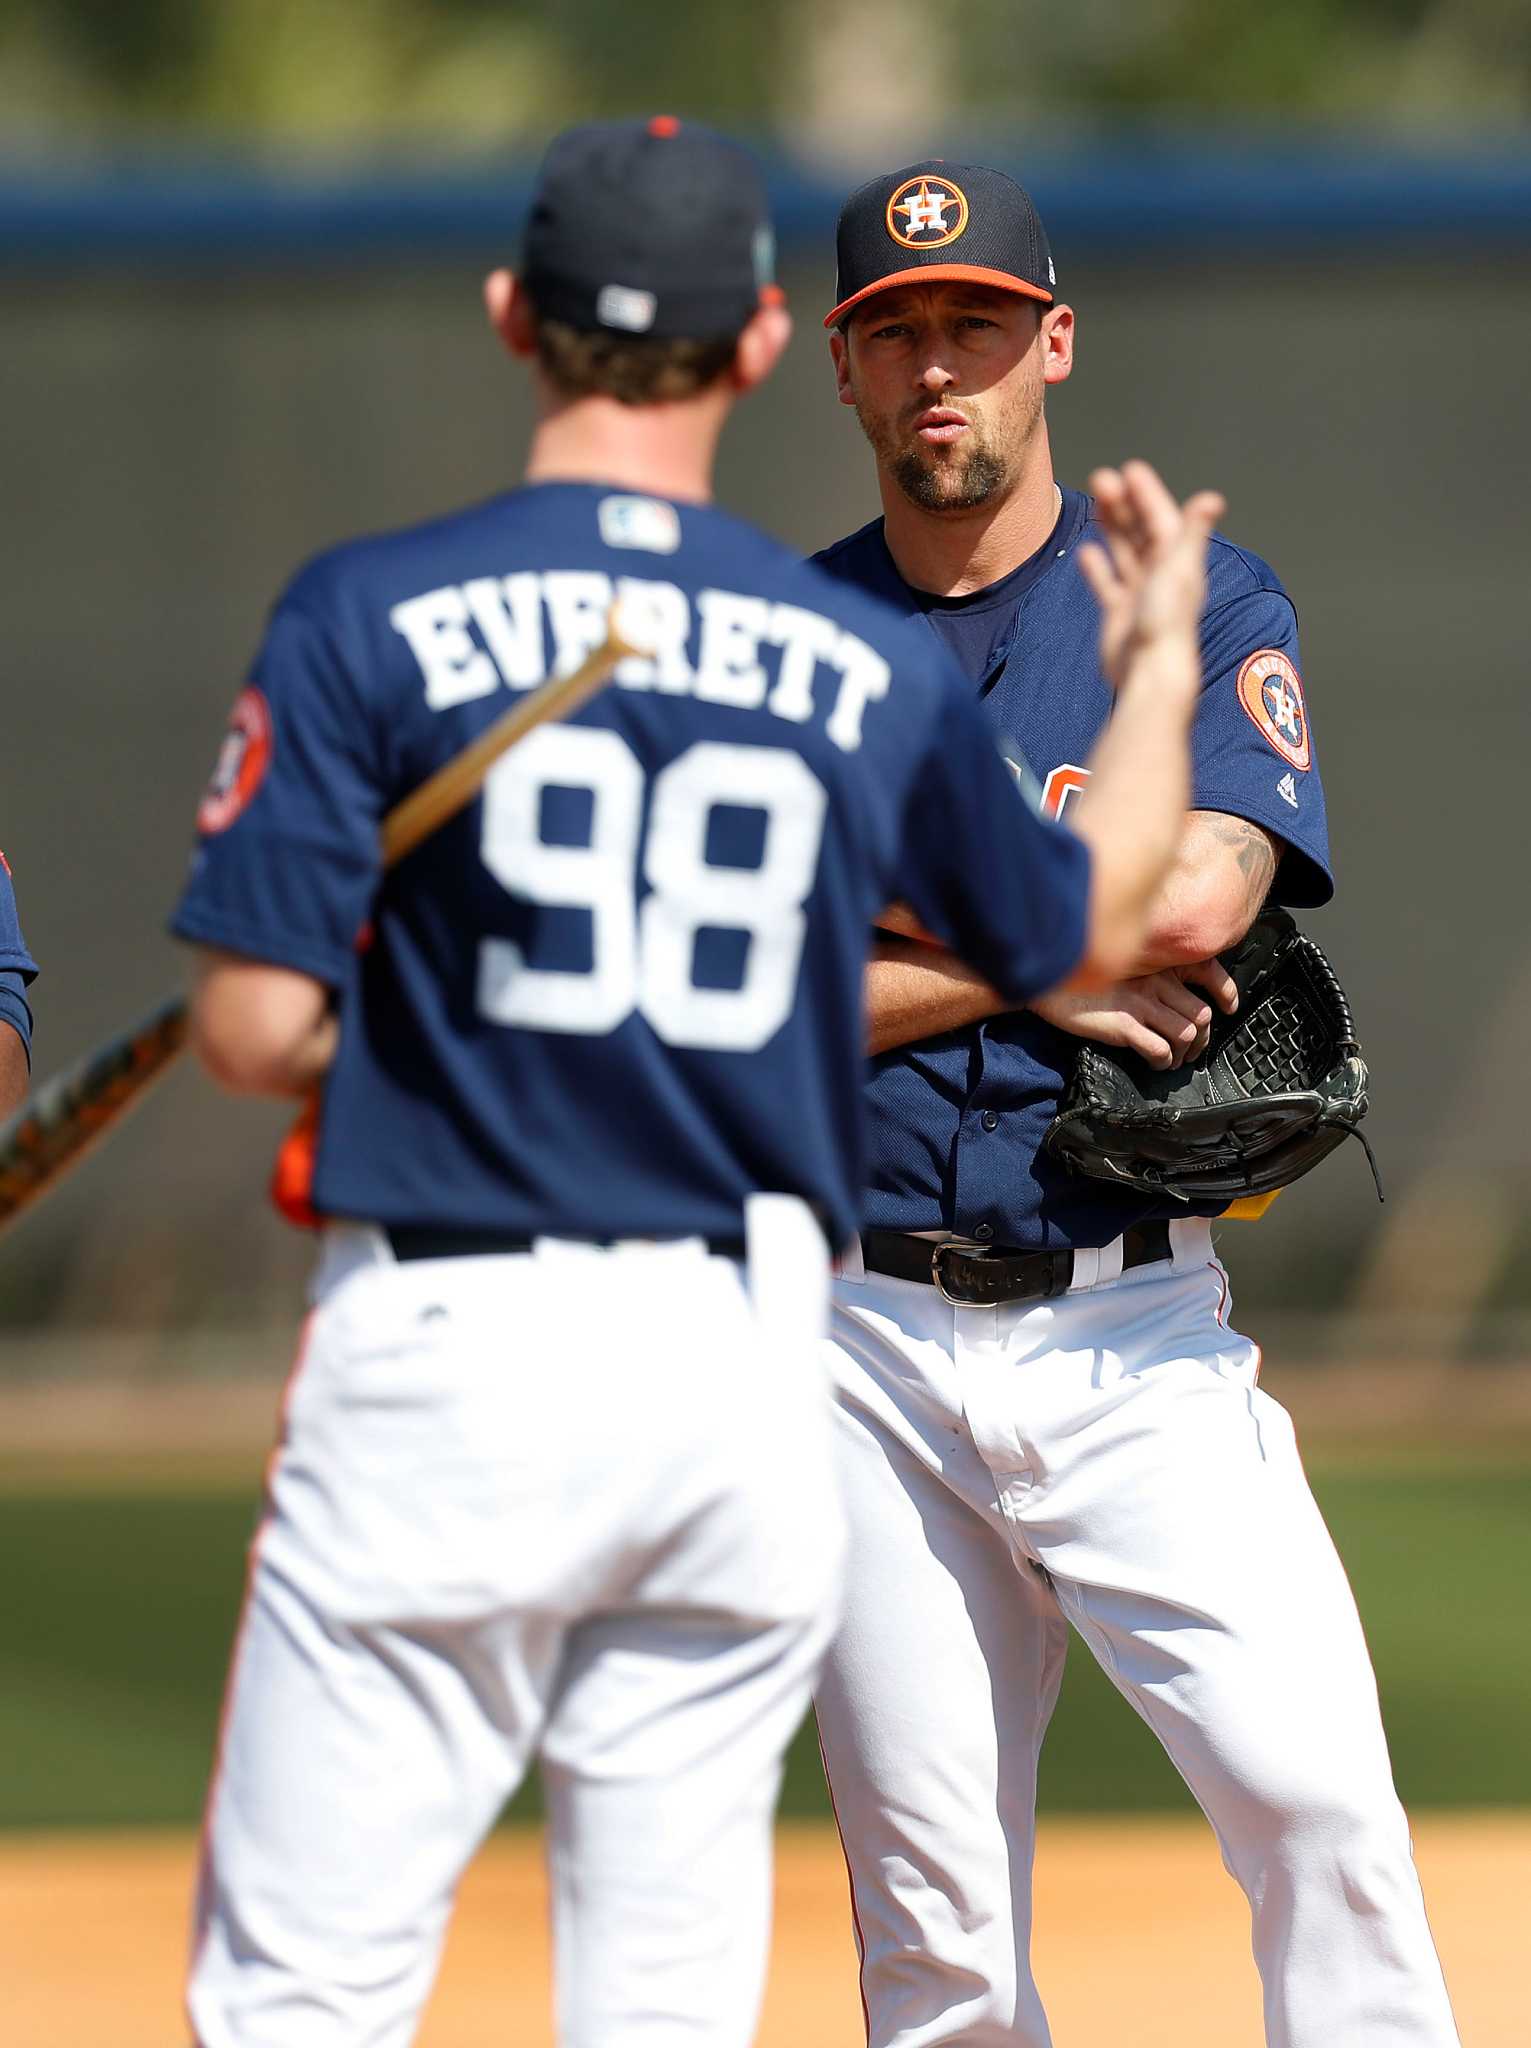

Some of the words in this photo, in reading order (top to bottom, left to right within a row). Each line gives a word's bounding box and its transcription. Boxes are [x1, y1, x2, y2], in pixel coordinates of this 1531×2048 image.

[904, 193, 947, 232] H
[390, 569, 892, 753] EVERETT
[476, 722, 829, 1054] 98
